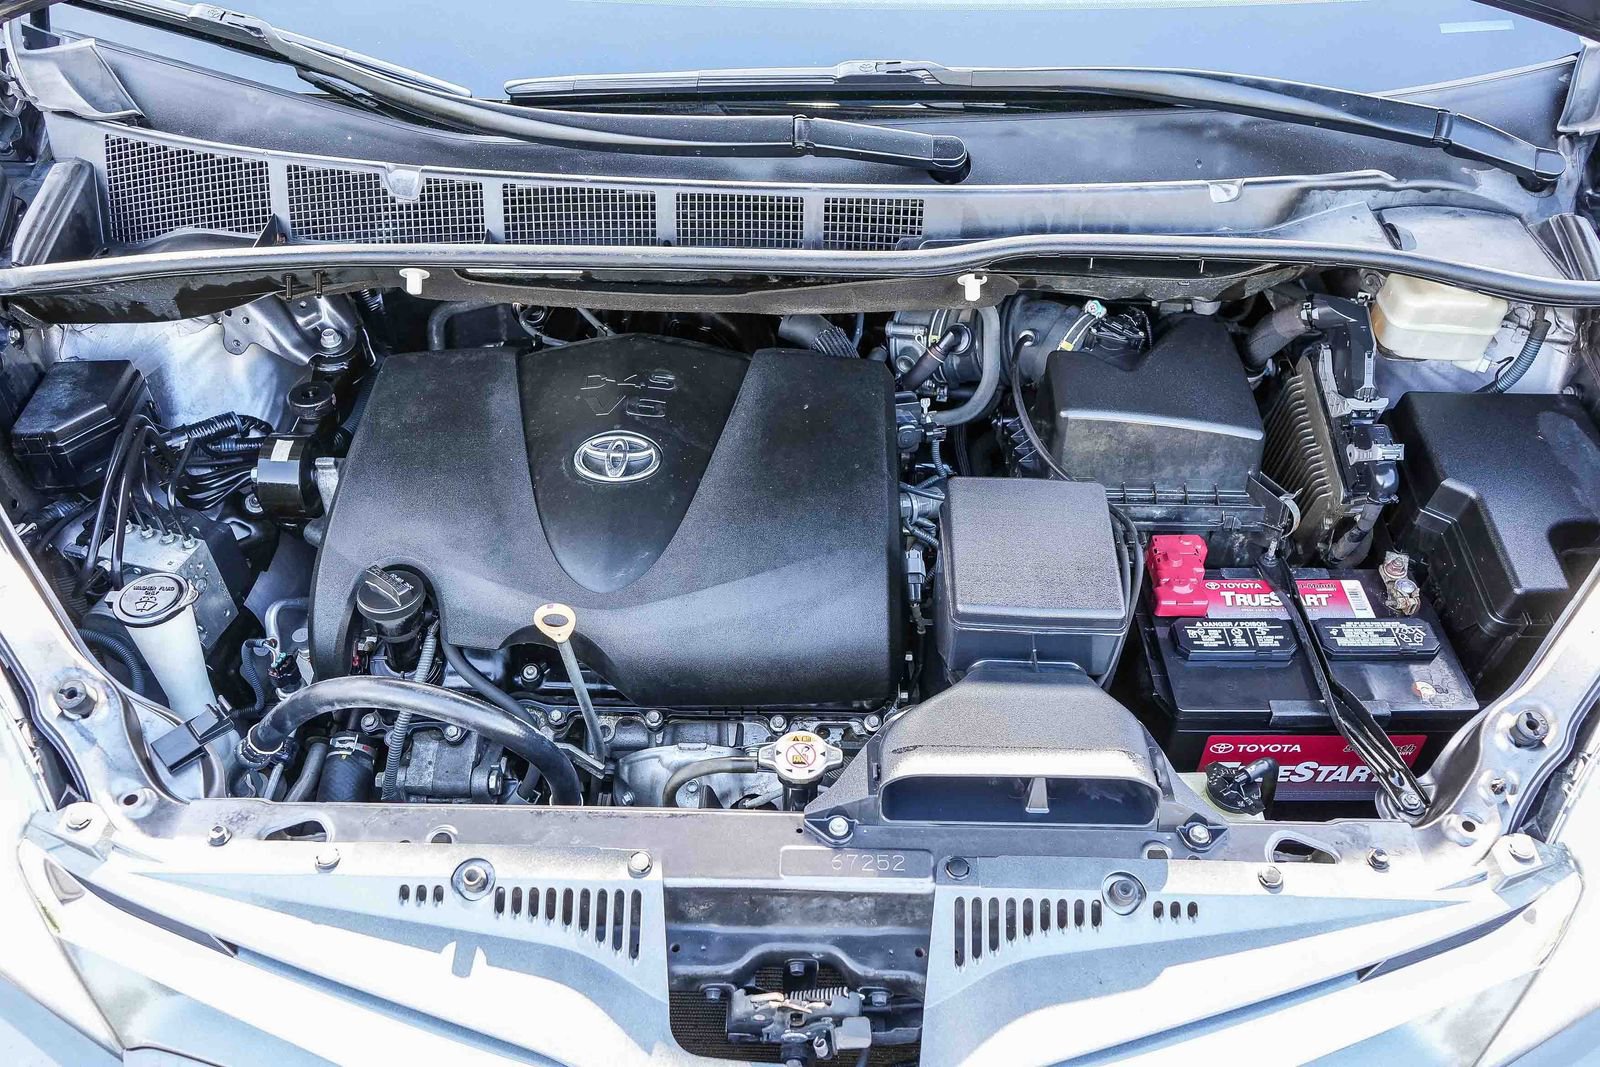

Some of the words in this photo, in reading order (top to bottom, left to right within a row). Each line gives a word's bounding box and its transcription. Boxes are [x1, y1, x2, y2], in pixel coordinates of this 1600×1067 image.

[584, 396, 667, 418] V6
[1219, 591, 1328, 607] TRUESRT
[1237, 743, 1302, 753] TOYOTA
[831, 854, 905, 871] 67252
